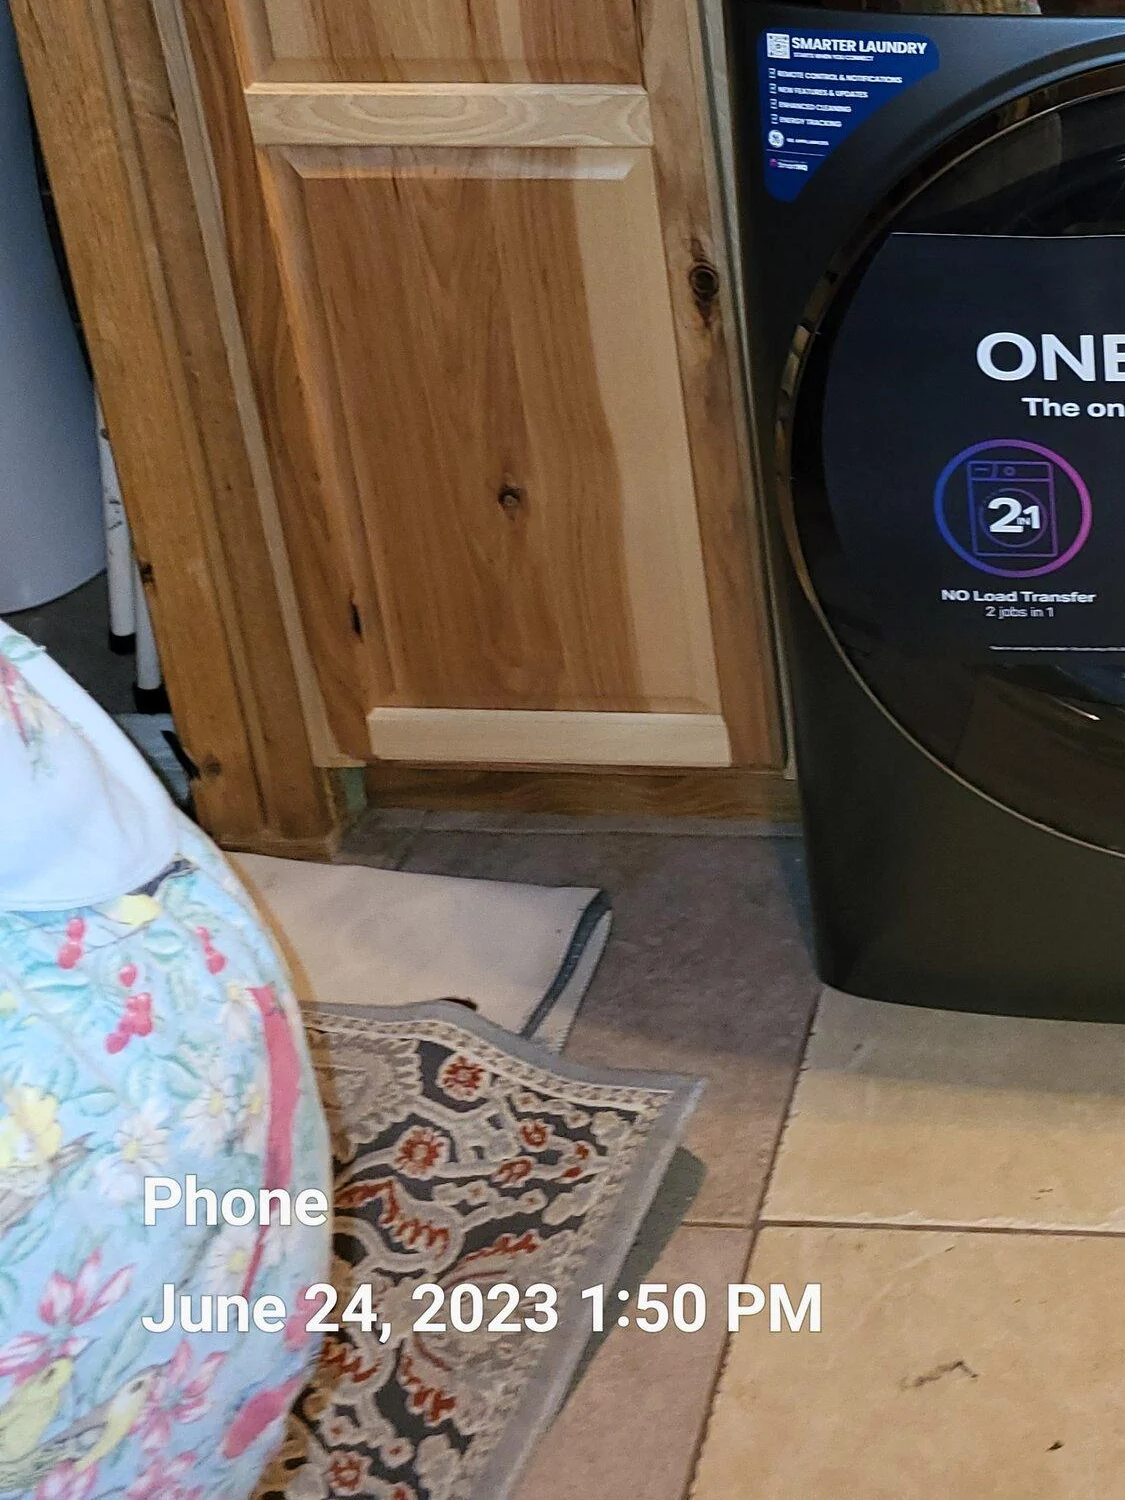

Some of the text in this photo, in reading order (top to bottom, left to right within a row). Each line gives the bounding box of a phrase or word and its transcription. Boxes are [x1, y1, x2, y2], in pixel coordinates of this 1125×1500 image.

[791, 37, 928, 55] SMARTER LAUNDRY
[805, 72, 838, 81] CONTROL
[1021, 397, 1081, 417] The
[987, 497, 1024, 533] 2
[1022, 505, 1041, 529] 1
[941, 589, 1097, 603] NO Load Transfer
[985, 606, 1054, 619] 2 jobs in 1
